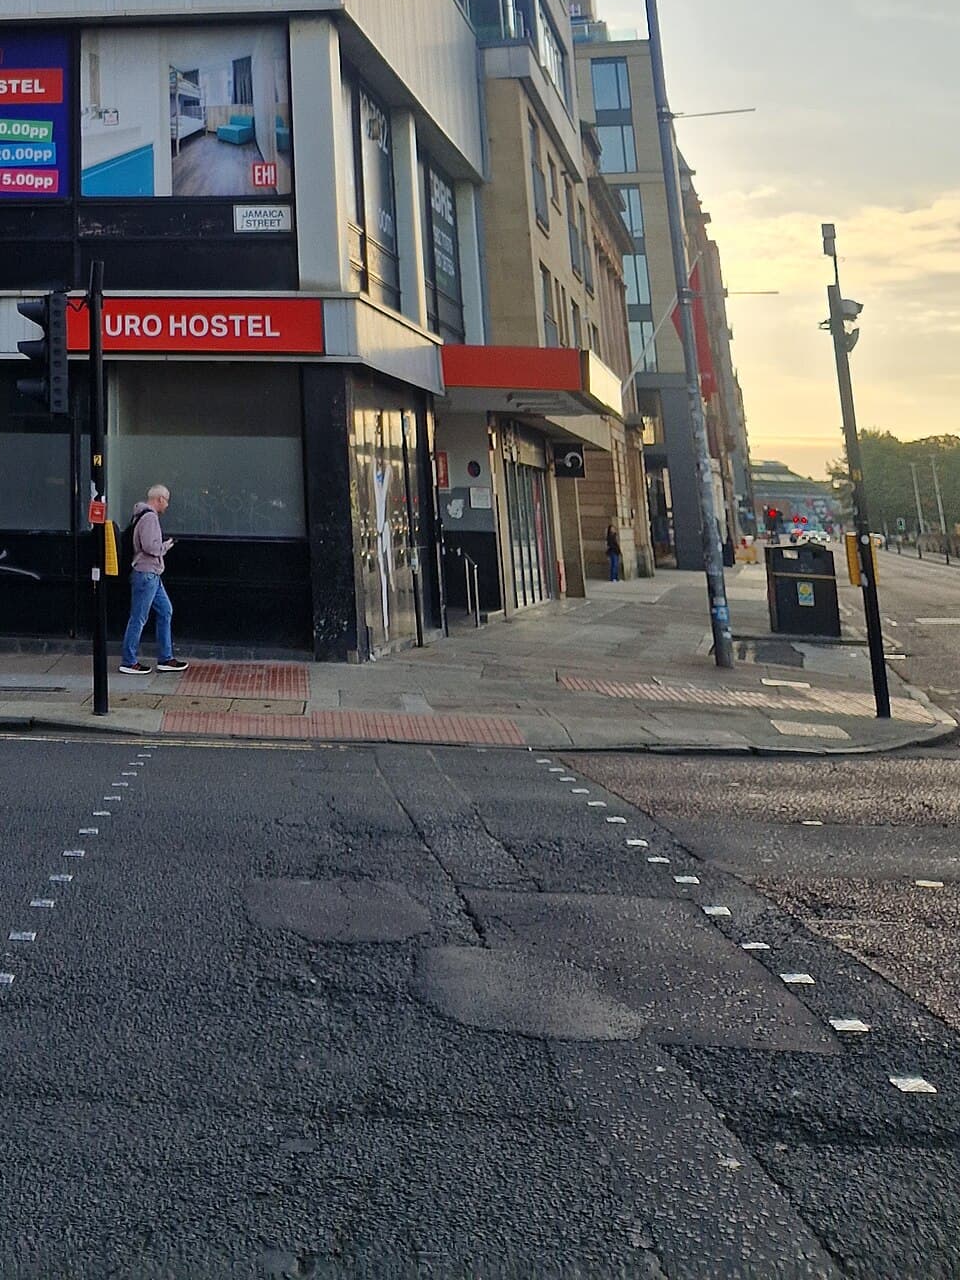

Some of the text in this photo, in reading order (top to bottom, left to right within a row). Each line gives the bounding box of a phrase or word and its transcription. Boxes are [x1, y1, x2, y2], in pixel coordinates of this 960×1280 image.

[254, 165, 276, 185] EH!
[242, 209, 284, 219] JAMAICA
[245, 219, 282, 228] STREET
[103, 314, 281, 337] URO HOSTEL
